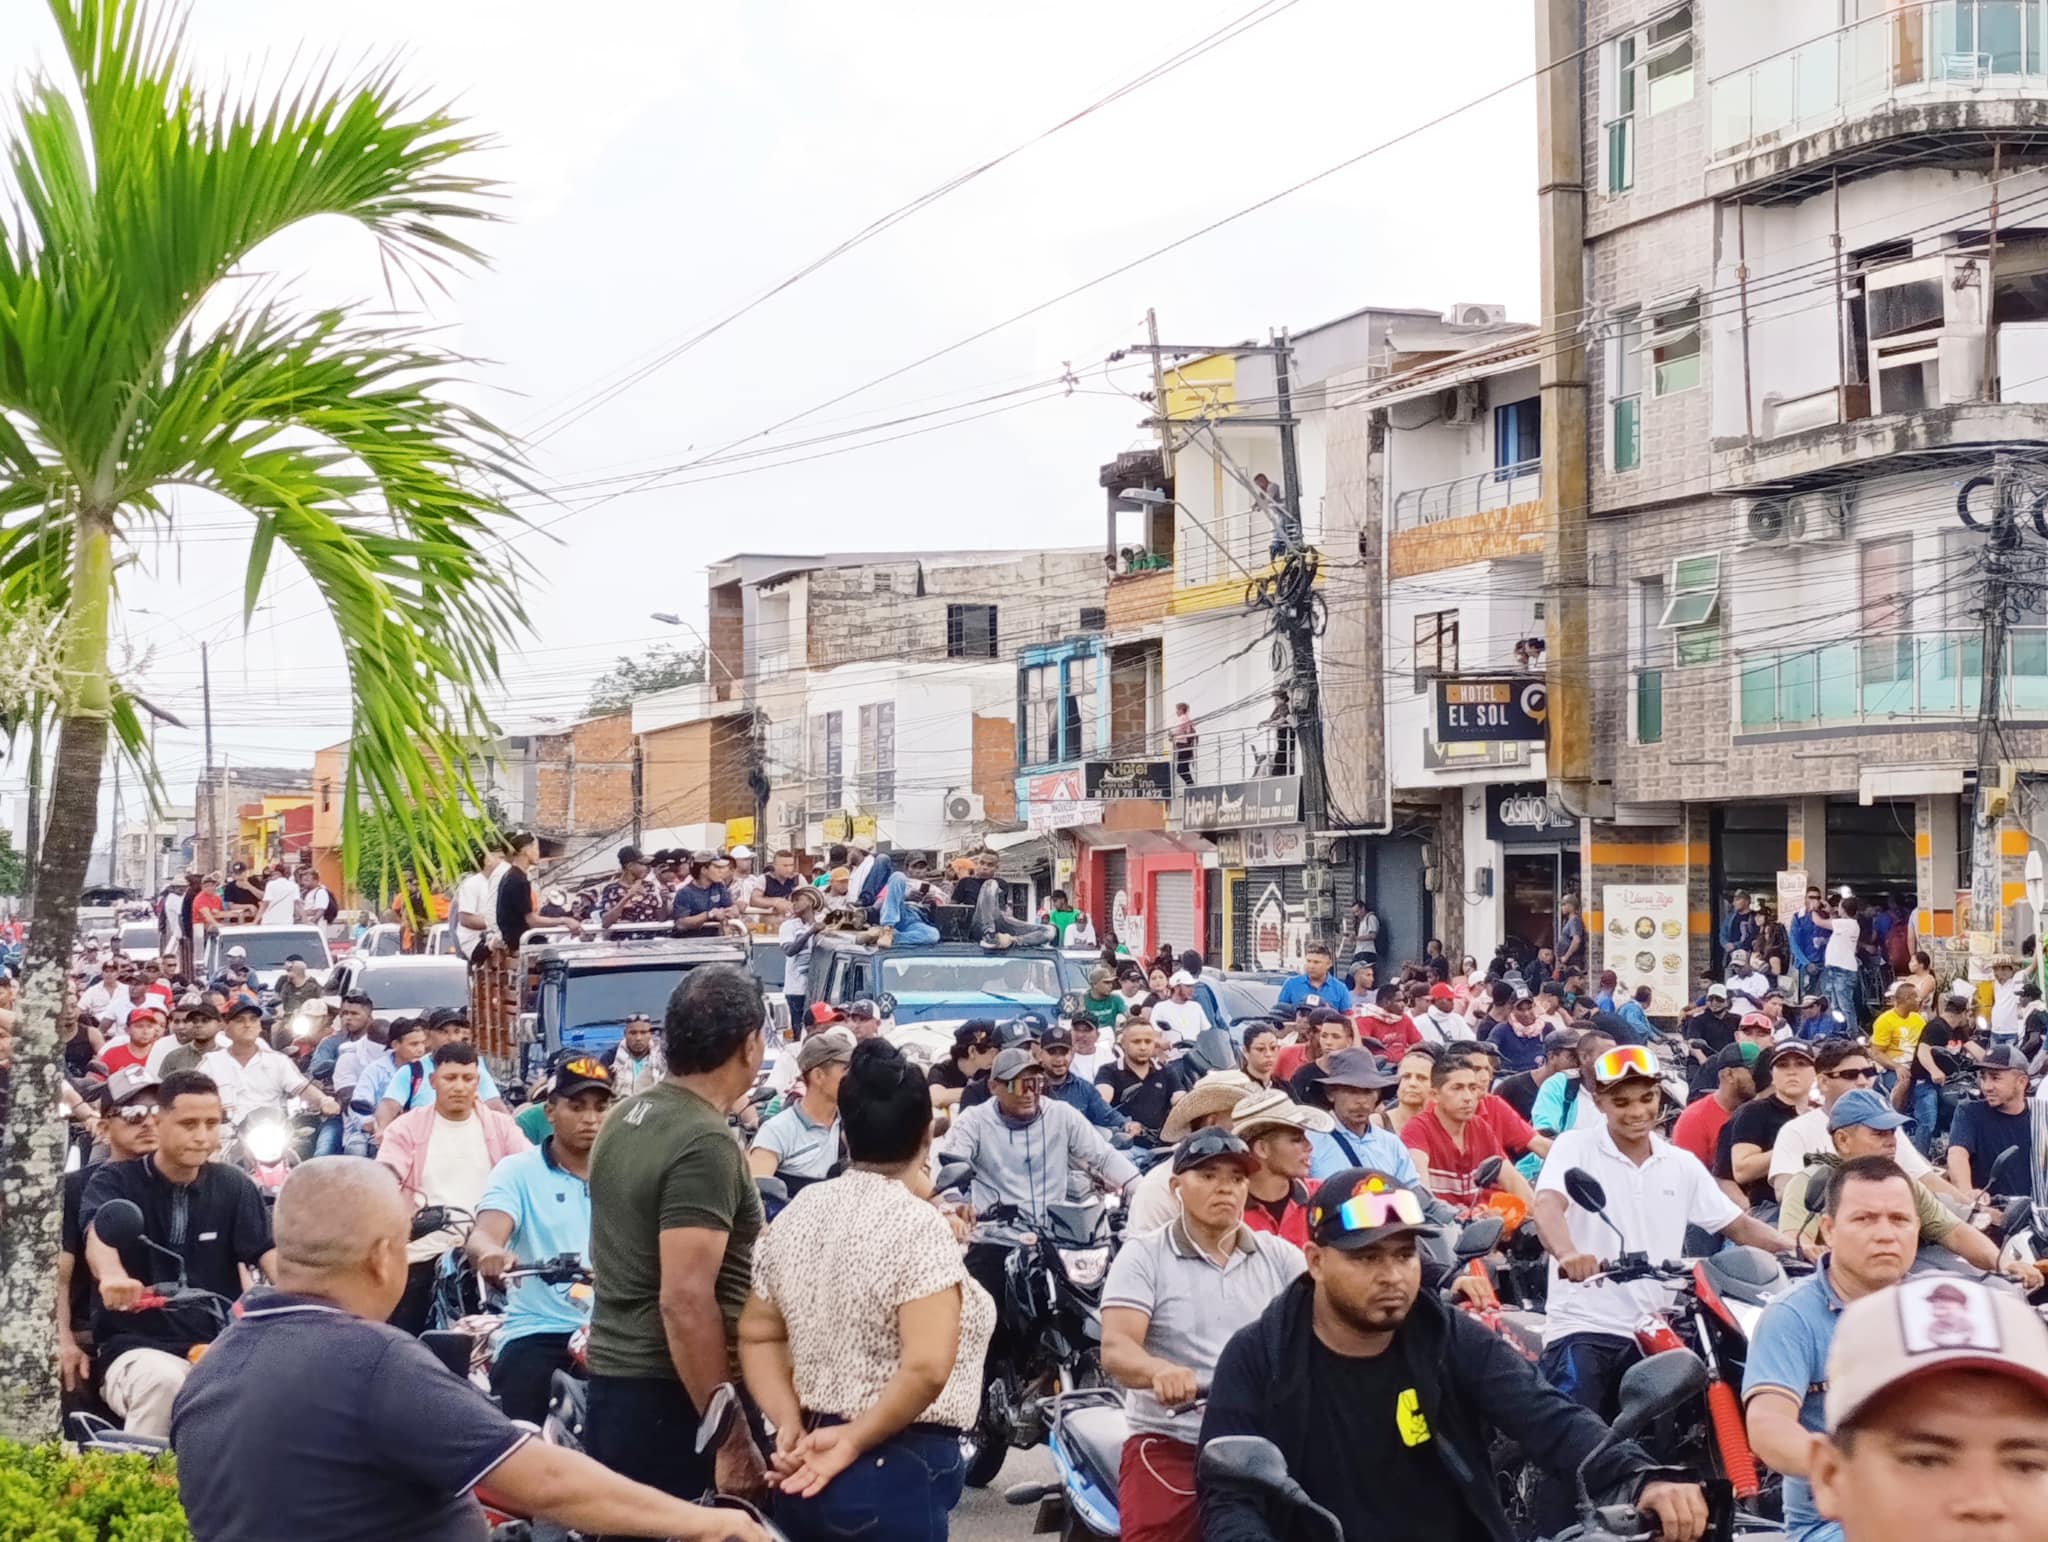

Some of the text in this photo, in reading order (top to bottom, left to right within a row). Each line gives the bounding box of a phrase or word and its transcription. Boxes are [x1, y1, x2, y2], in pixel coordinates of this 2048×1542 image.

[1460, 685, 1497, 701] HOTEL
[1449, 704, 1509, 726] EL SOL
[1112, 762, 1148, 775] Hotel
[1184, 794, 1218, 826] Hotel
[1500, 799, 1544, 824] CASINO
